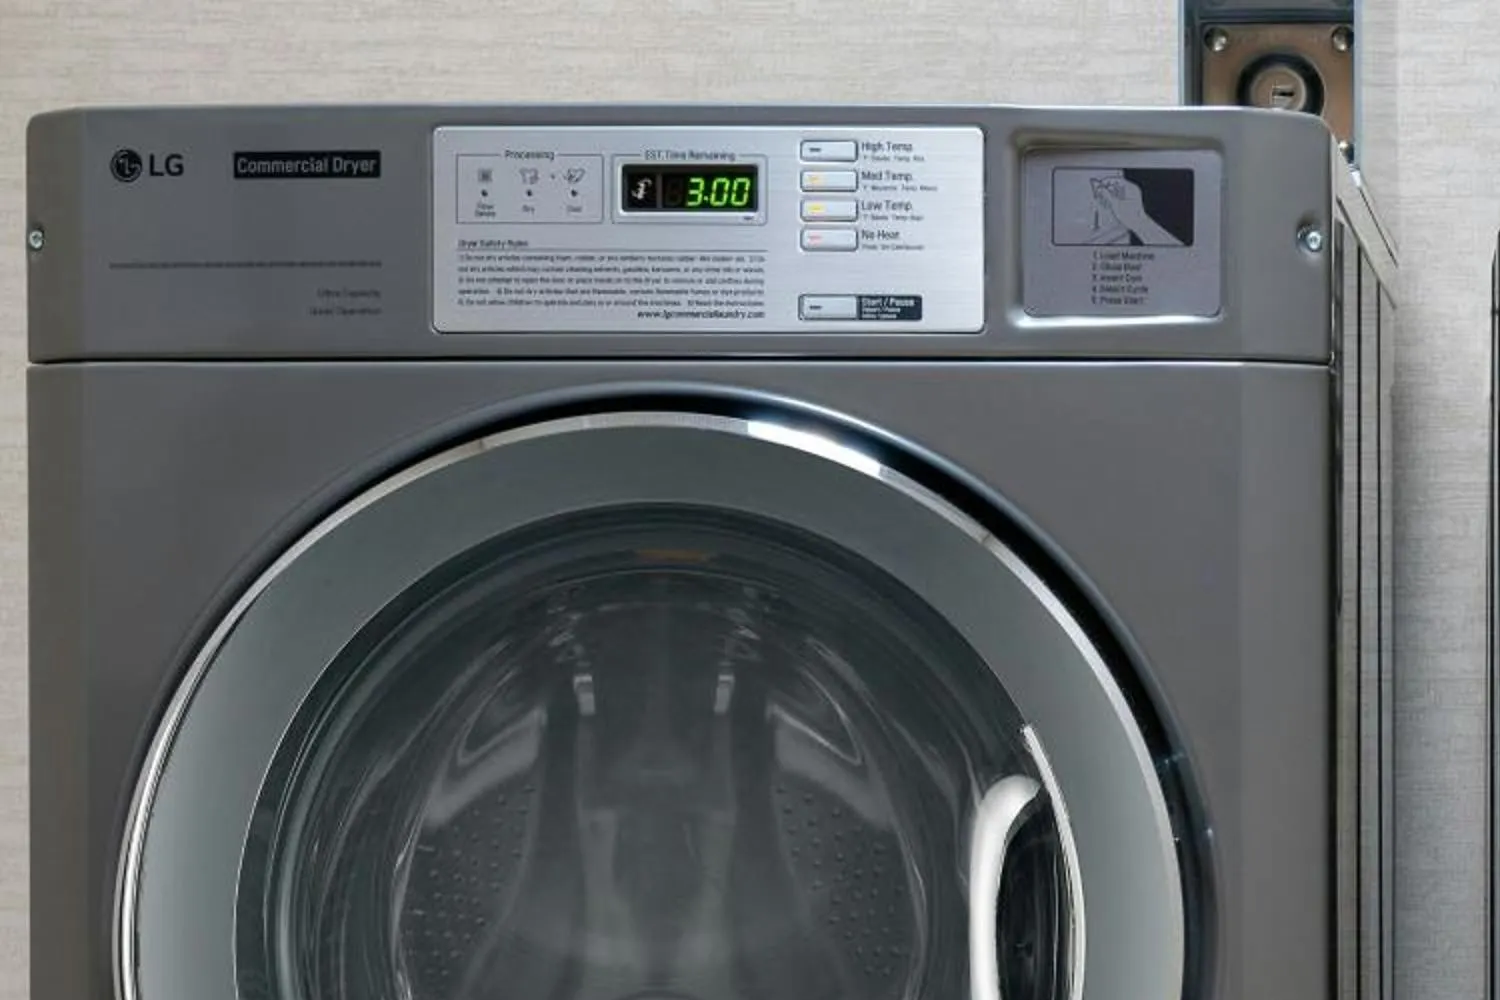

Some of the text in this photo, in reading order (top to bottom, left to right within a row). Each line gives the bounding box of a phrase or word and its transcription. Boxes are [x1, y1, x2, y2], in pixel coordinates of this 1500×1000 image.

[862, 141, 883, 152] High
[505, 149, 555, 161] Processing
[149, 153, 185, 177] LG
[237, 156, 378, 178] Commercial Dryer
[862, 200, 882, 211] Low
[862, 229, 900, 240] No Heat
